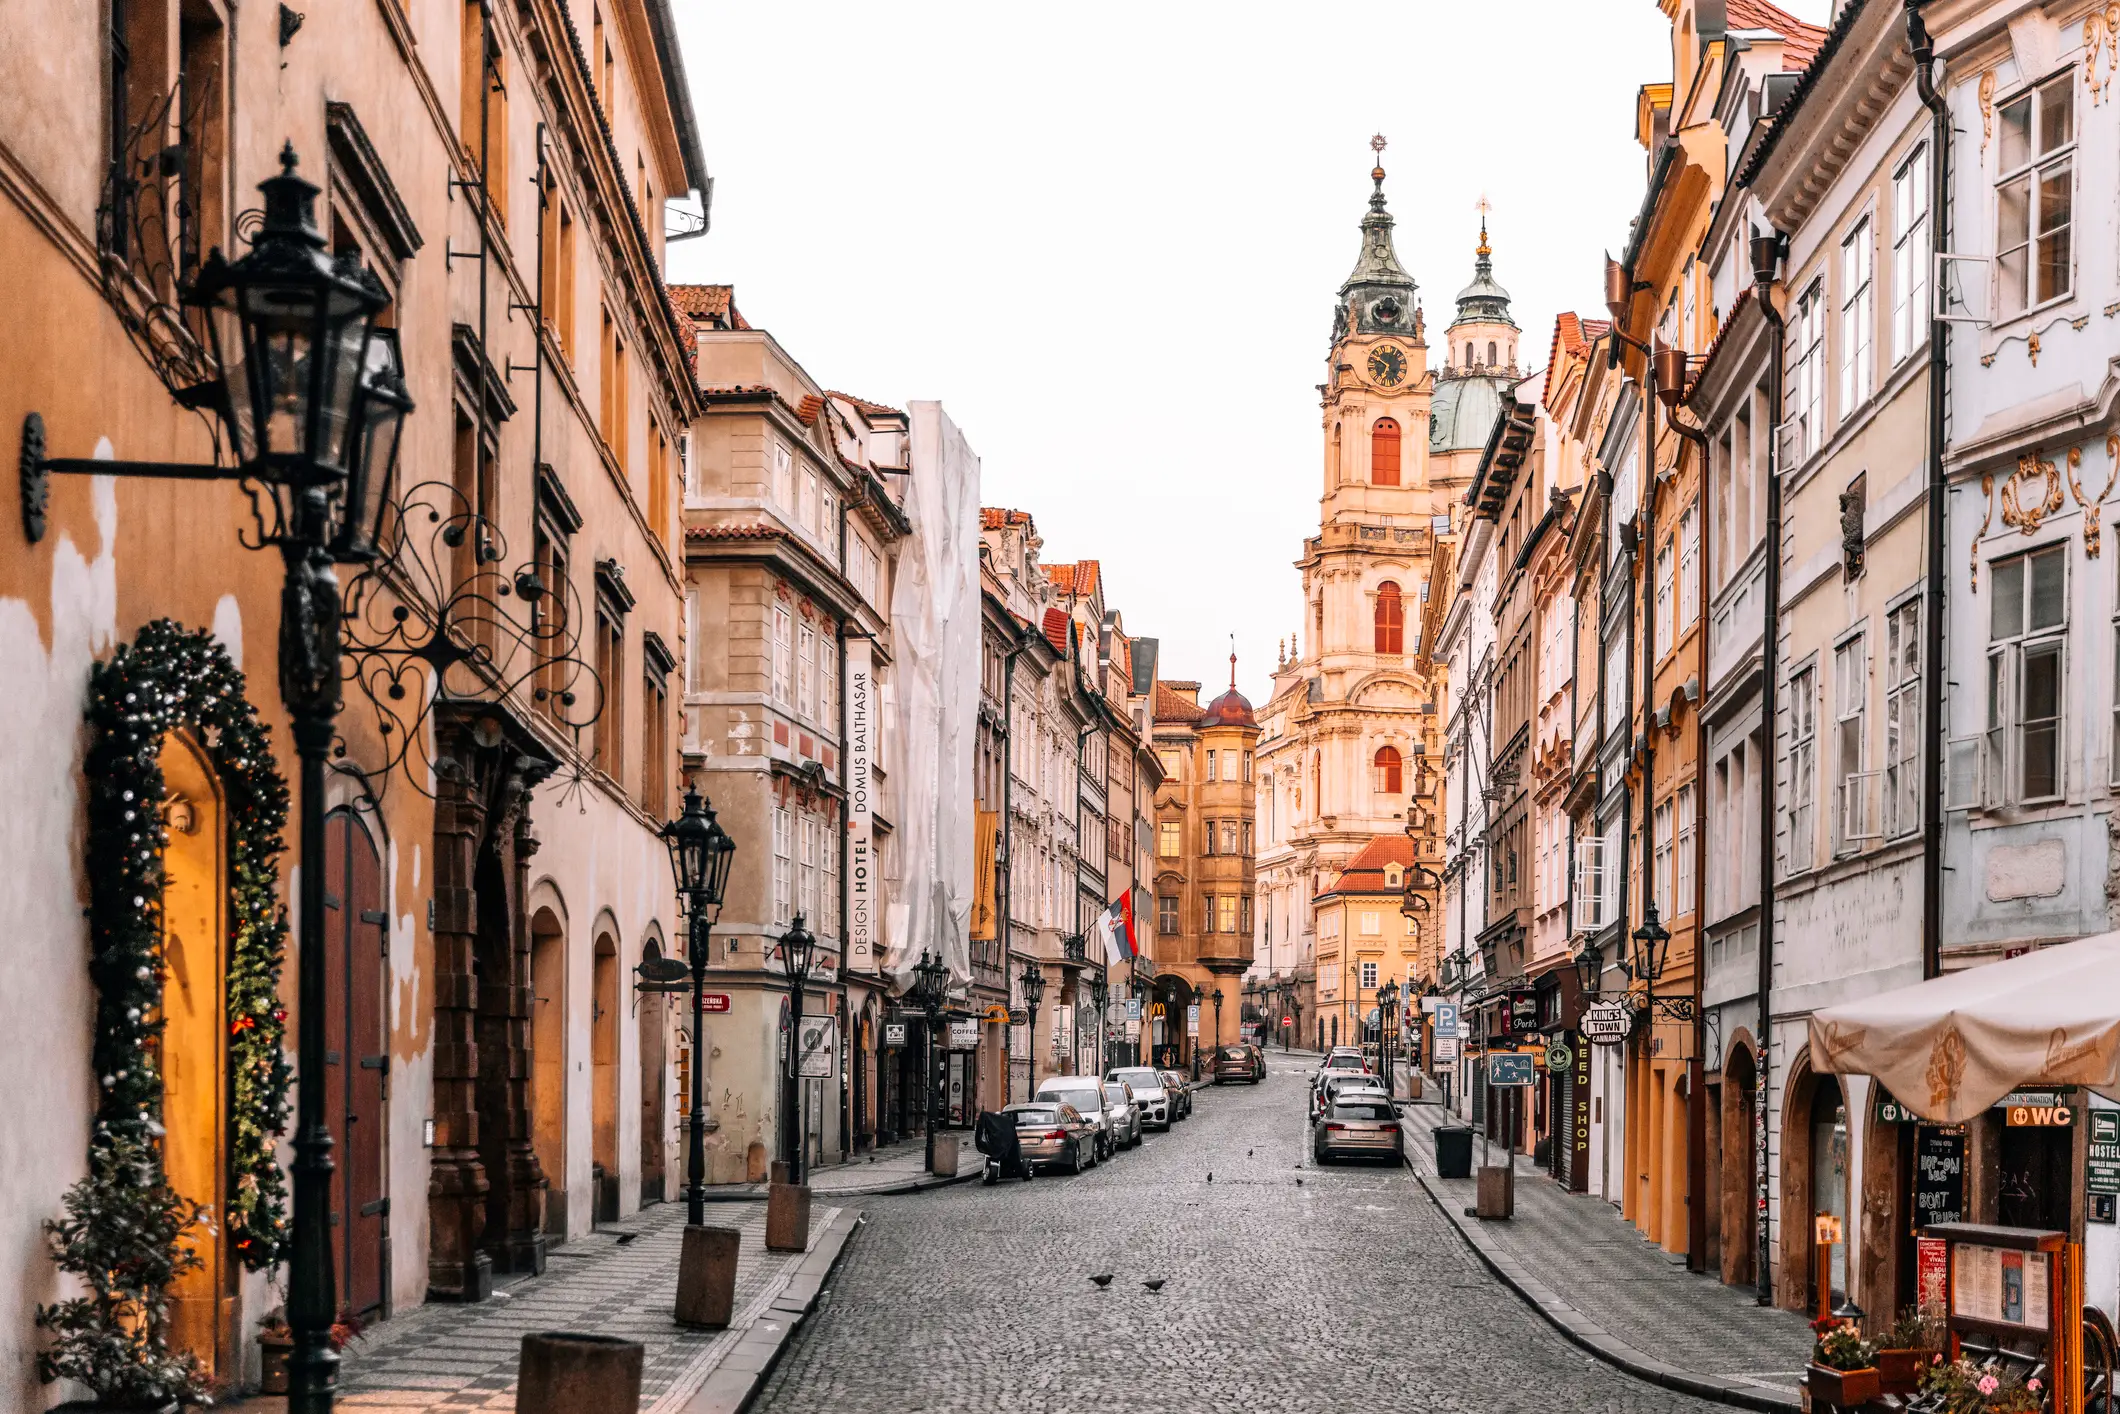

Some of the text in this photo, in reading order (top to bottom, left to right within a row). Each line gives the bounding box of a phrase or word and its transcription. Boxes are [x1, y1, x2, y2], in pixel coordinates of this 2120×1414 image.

[854, 672, 868, 955] DESIGN HOTEL DOMUS BALTHASAR
[702, 996, 723, 1005] ZEŇSKÁ
[1440, 1007, 1453, 1026] P
[1592, 1009, 1620, 1020] KING'S
[1592, 1022, 1621, 1032] TOWN
[1592, 1034, 1622, 1043] CANNABIS
[1577, 1035, 1588, 1151] WEED SHOP
[2031, 1107, 2071, 1126] WC
[2089, 1144, 2120, 1159] HOSTEL
[1918, 1191, 1950, 1209] BOAT
